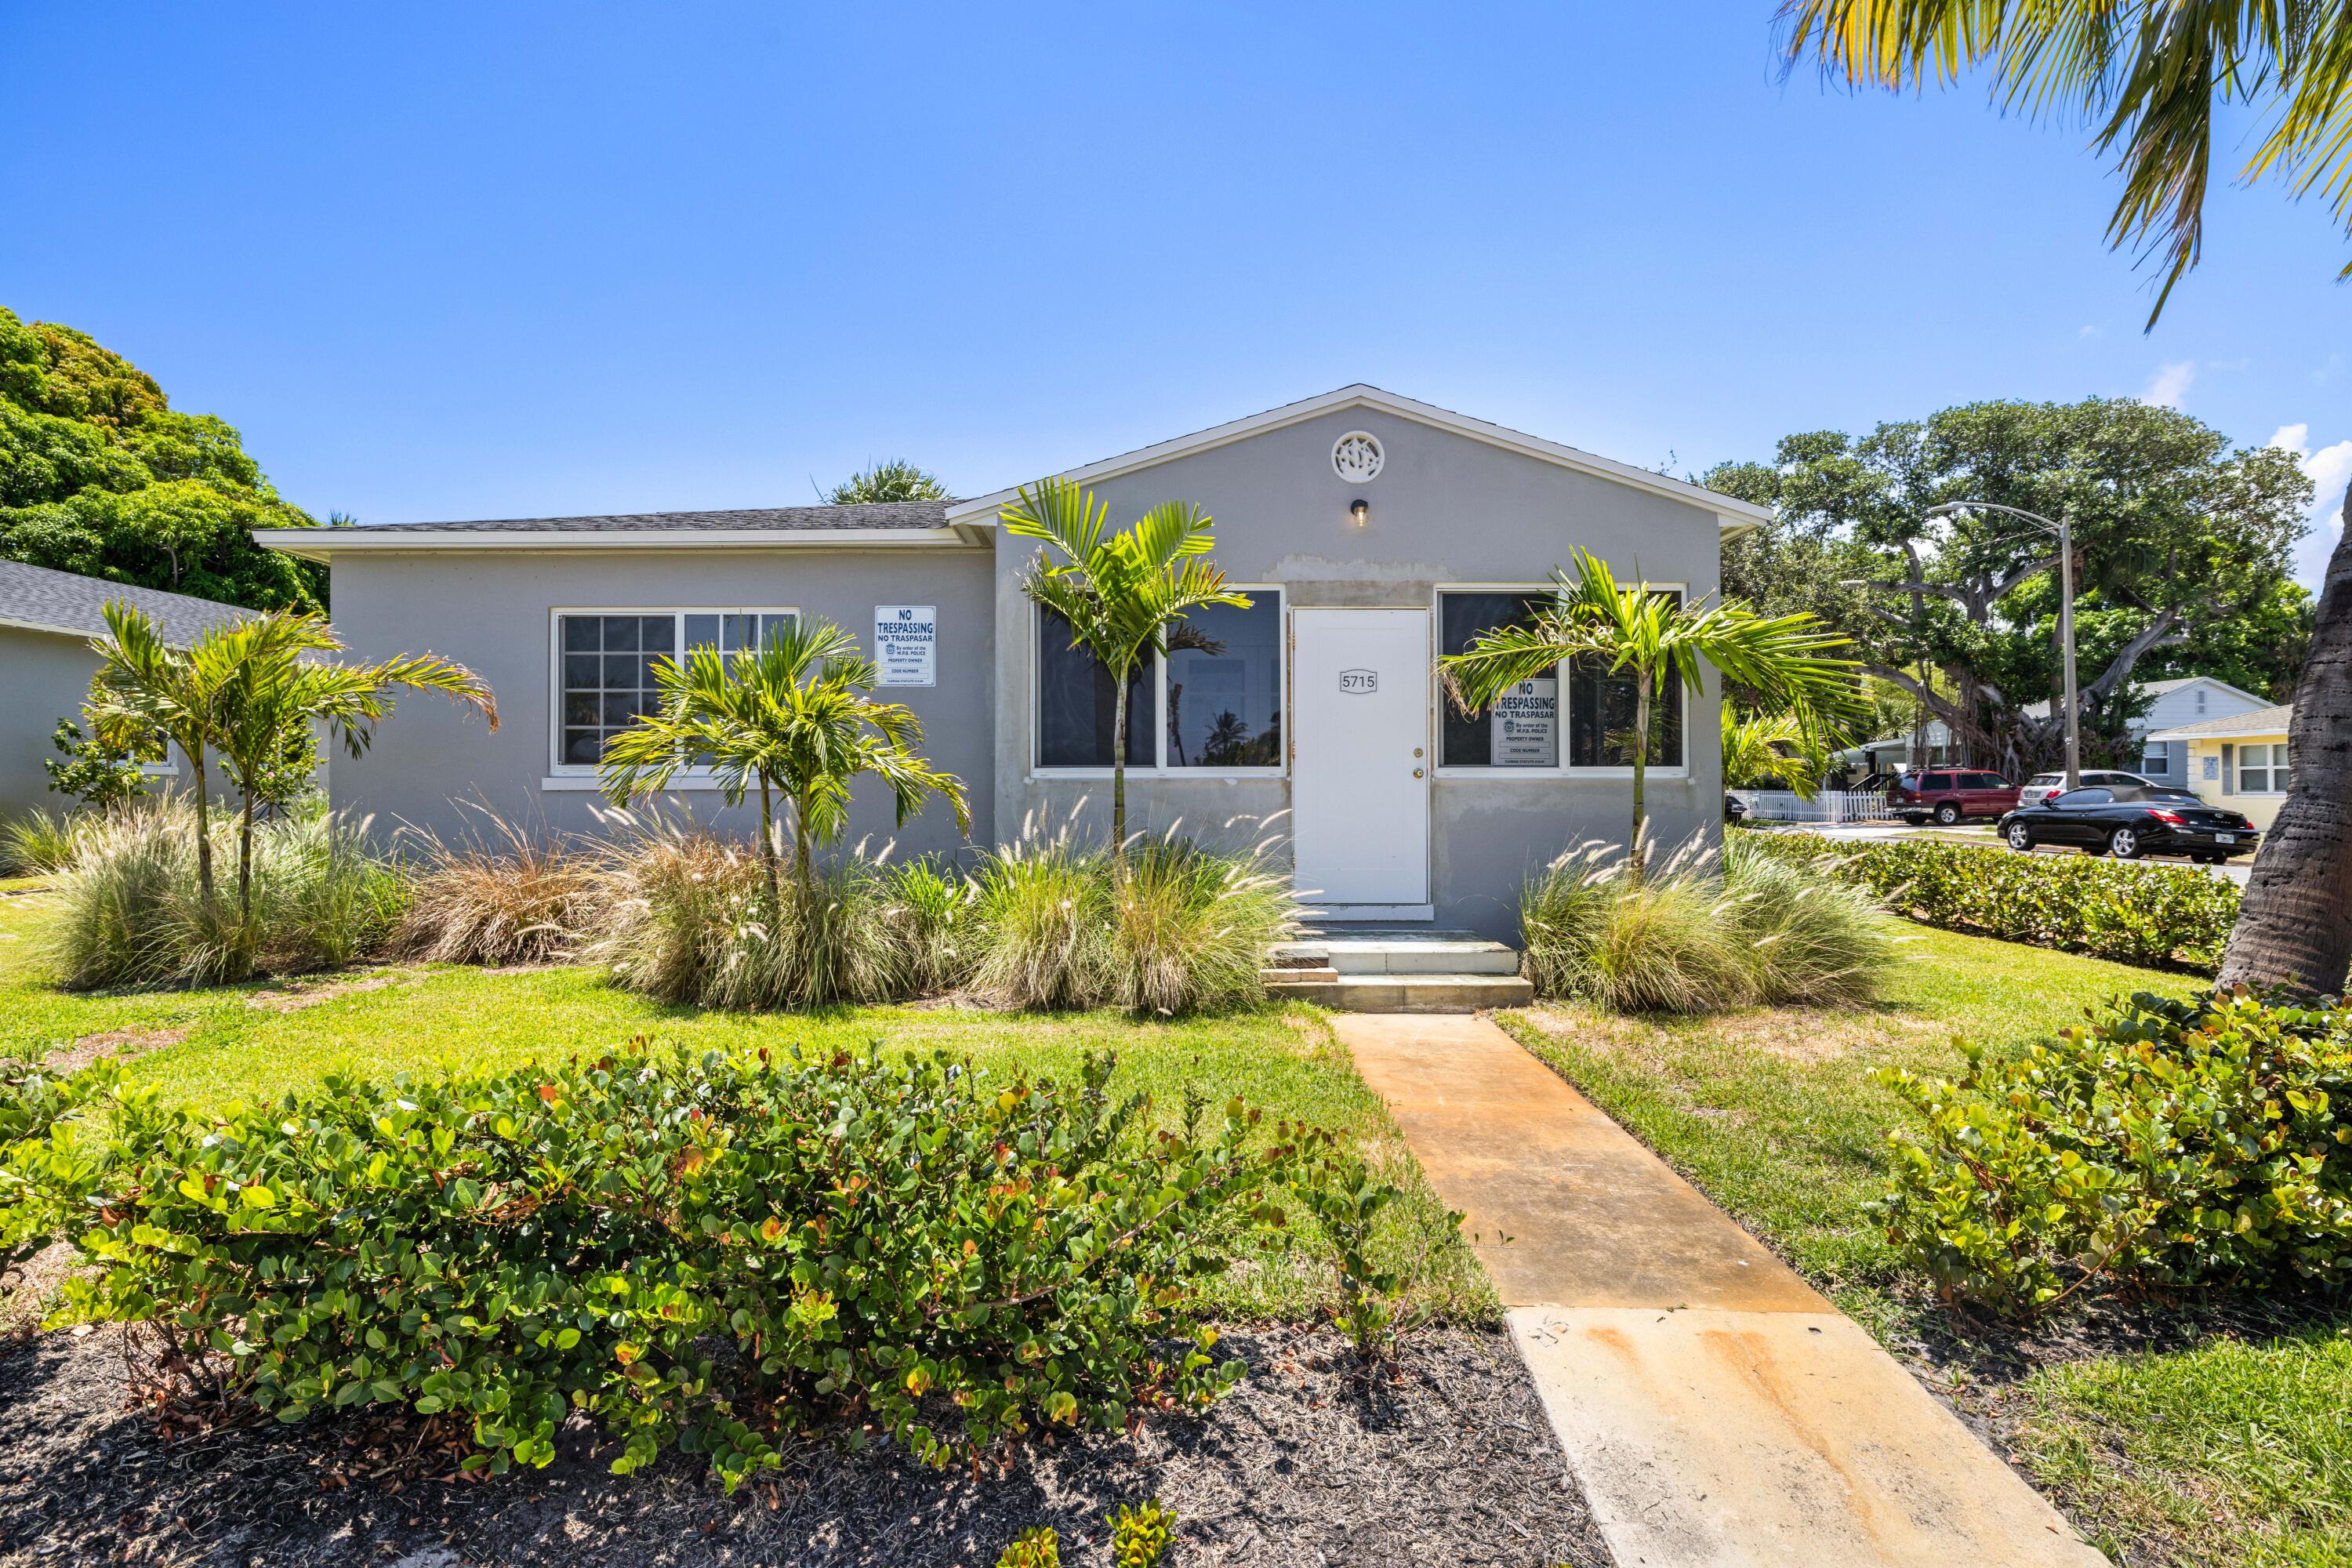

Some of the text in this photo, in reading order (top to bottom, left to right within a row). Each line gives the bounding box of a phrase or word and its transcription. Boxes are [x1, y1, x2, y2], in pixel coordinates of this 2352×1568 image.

[899, 610, 911, 621] NO
[878, 623, 933, 634] TRESPASSING
[1343, 676, 1374, 687] 5715
[1519, 683, 1533, 695] NO
[1495, 697, 1554, 710] TRESPASSING
